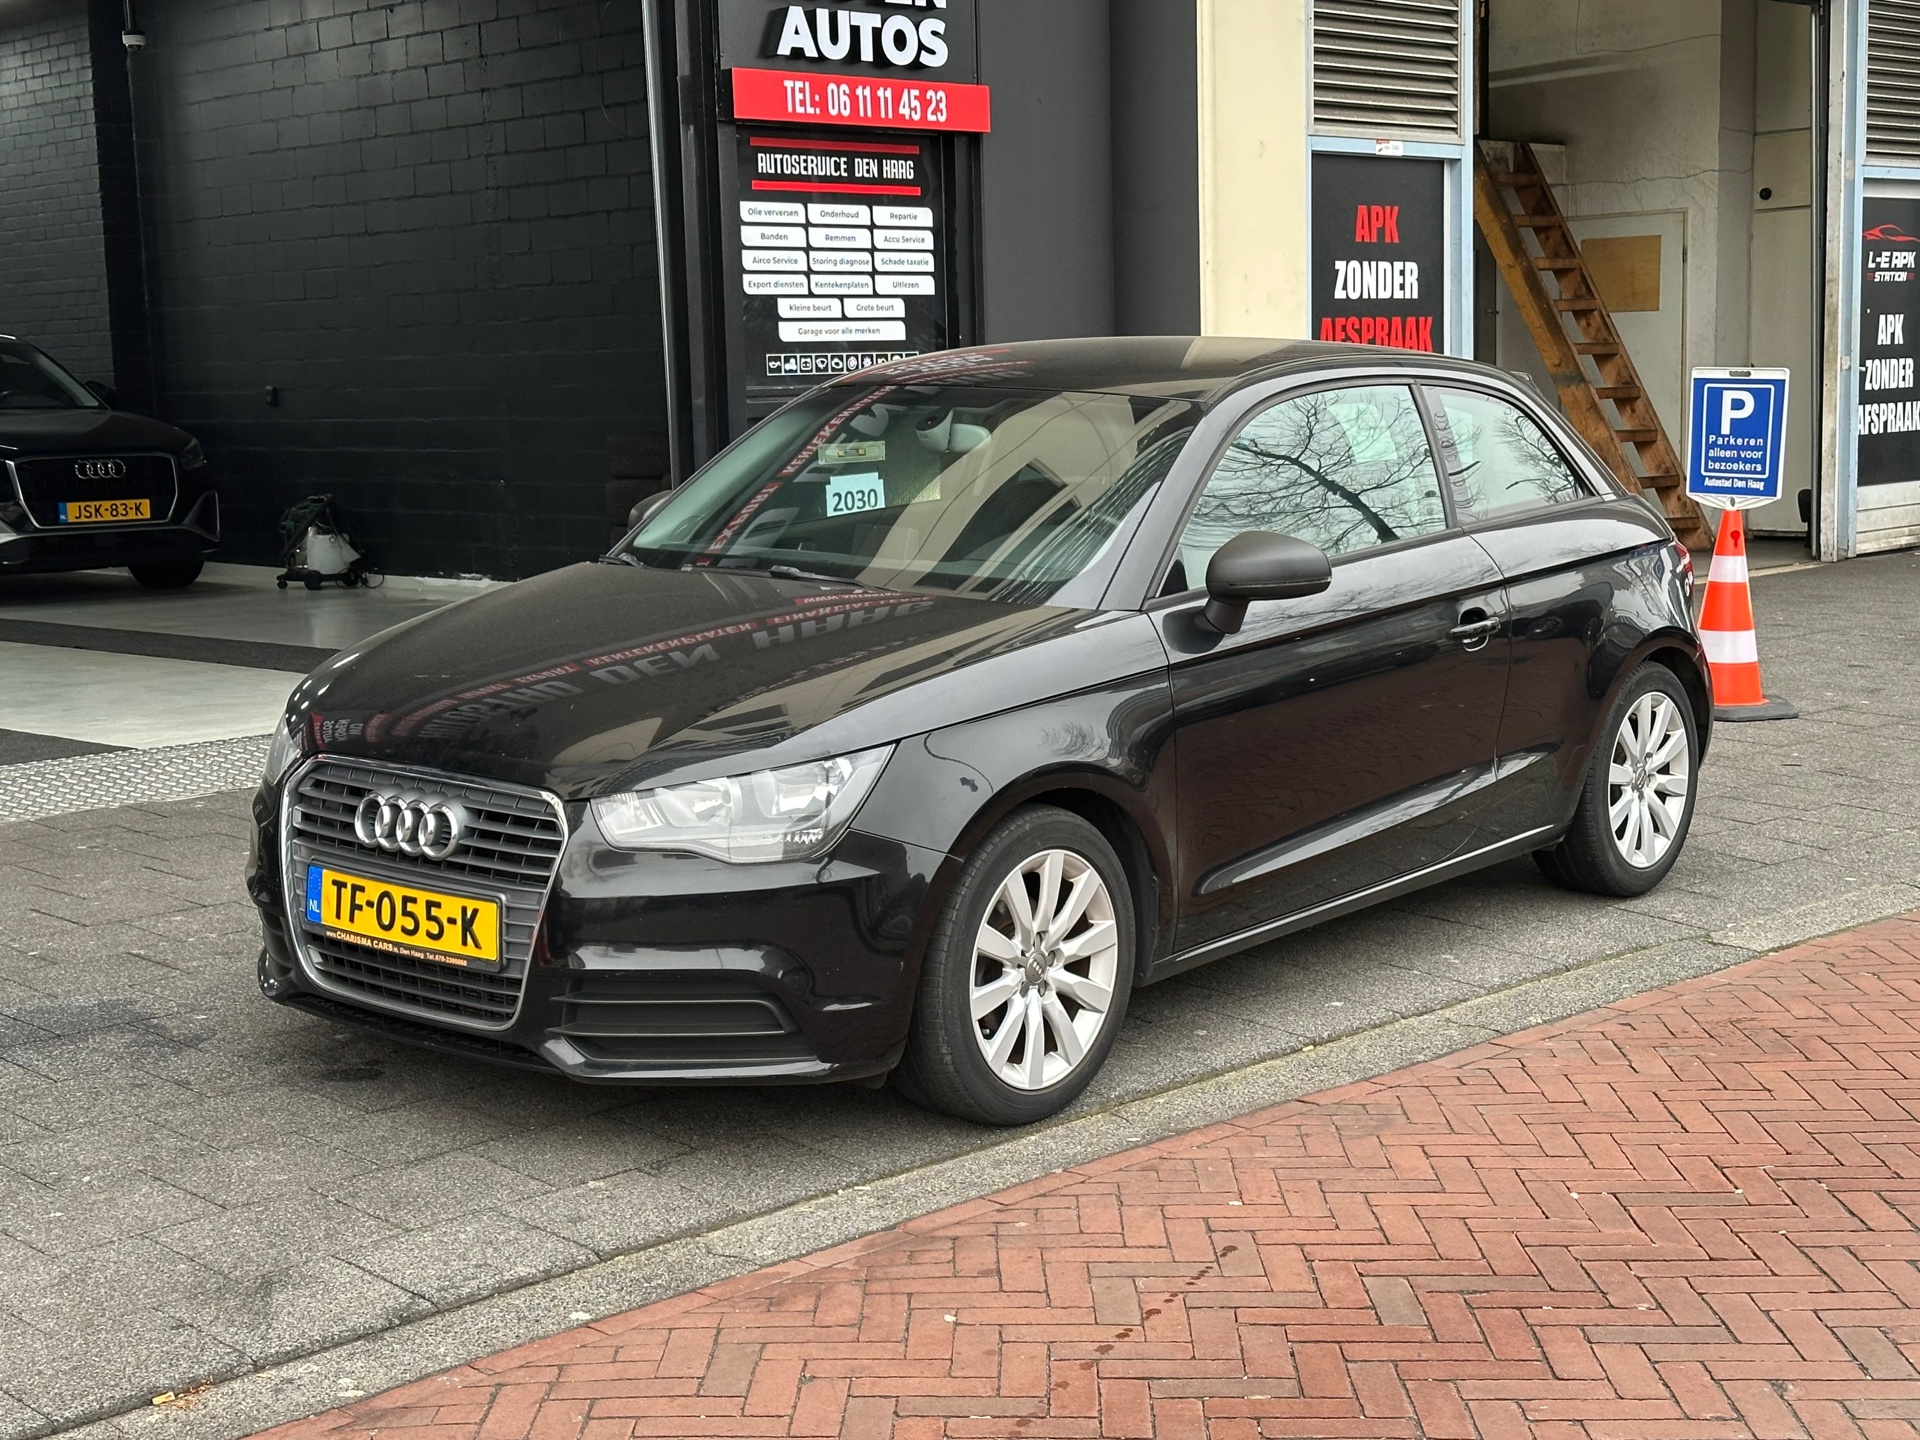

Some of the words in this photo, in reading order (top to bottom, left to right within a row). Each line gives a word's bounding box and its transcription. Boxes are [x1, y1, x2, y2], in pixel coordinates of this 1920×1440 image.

[776, 5, 949, 68] AUTOS
[783, 79, 820, 115] TEL:
[827, 83, 851, 117] 06
[855, 85, 872, 118] 11
[877, 87, 893, 119] 11
[899, 88, 921, 121] 45
[926, 90, 947, 123] 23
[757, 152, 848, 177] AUTOSERVICE
[855, 158, 878, 178] DEN
[883, 159, 915, 180] HAAG
[748, 207, 763, 216] Olie
[764, 209, 799, 217] verversen
[820, 210, 859, 219] Onderhoud
[889, 212, 918, 222] Repartie
[1355, 204, 1400, 244] APK
[760, 232, 788, 241] Banden
[825, 234, 856, 242] Remmen
[883, 235, 901, 243] Accu
[902, 235, 925, 244] Service
[752, 256, 771, 265] Airco
[772, 256, 798, 265] Service
[812, 257, 837, 267] Storing
[839, 257, 870, 267] diagnose
[881, 257, 905, 266] Schade
[906, 258, 929, 266] taxatie
[1868, 251, 1891, 268] L-E
[1891, 251, 1917, 268] APK
[1334, 260, 1419, 300] ZONDER
[1874, 271, 1908, 282] STATION
[748, 280, 772, 289] Export
[773, 280, 804, 288] diensten
[815, 281, 869, 290] Kentekenplaten
[892, 281, 920, 289] Uitlezen
[789, 304, 811, 312] Kleine
[813, 304, 832, 312] beurt
[856, 304, 877, 312] Grote
[878, 304, 894, 312] beurt
[798, 327, 823, 336] Garage
[841, 327, 853, 335] alle
[855, 327, 881, 335] merken
[1320, 316, 1433, 353] AFSPRAAK
[1877, 314, 1904, 345] APK
[1864, 357, 1914, 391] ZONDER
[1721, 390, 1755, 435] P
[1858, 400, 1920, 436] AFSPRAAK
[1708, 435, 1764, 446] Parkeren
[1708, 447, 1737, 458] alleen
[1740, 450, 1763, 459] voor
[1708, 459, 1762, 472] bezoekers
[1704, 477, 1732, 488] Autostad
[1733, 478, 1747, 488] Den
[1747, 479, 1764, 491] Haag
[832, 488, 878, 512] 2030
[74, 502, 144, 520] JSK-83-K
[309, 898, 320, 913] NL
[331, 879, 482, 949] TF-055-K
[400, 947, 410, 955] Den
[411, 948, 424, 959] Haag
